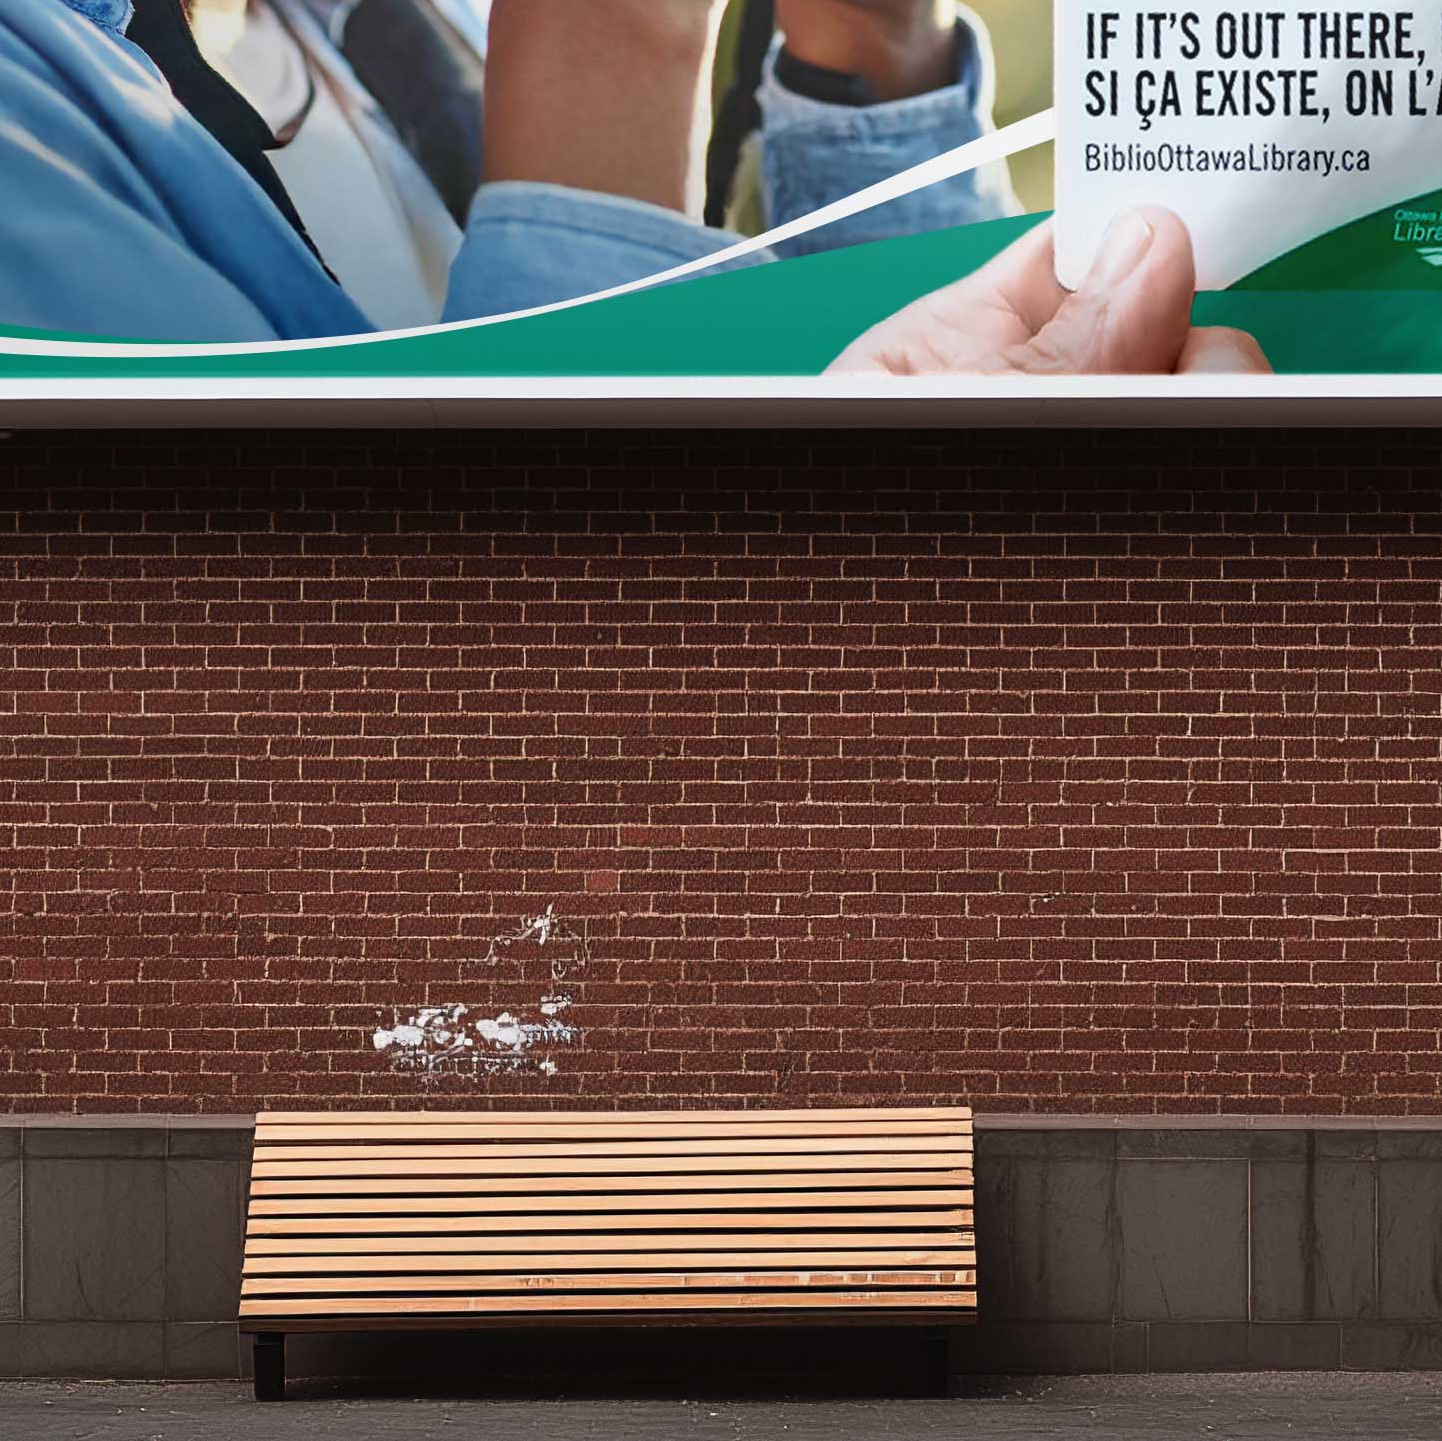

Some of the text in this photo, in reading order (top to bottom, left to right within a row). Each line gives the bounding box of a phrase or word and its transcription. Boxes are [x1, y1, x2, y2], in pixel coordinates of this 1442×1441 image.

[1087, 13, 1120, 59] IF
[1216, 12, 1286, 60] OUT
[1297, 12, 1425, 66] THERE,
[1085, 70, 1118, 117] SI
[1135, 70, 1181, 131] ÇA
[1196, 70, 1330, 124] EXISTE,
[1345, 69, 1393, 117] ON
[1085, 143, 1371, 178] BiblioOttawaLibrary.ca
